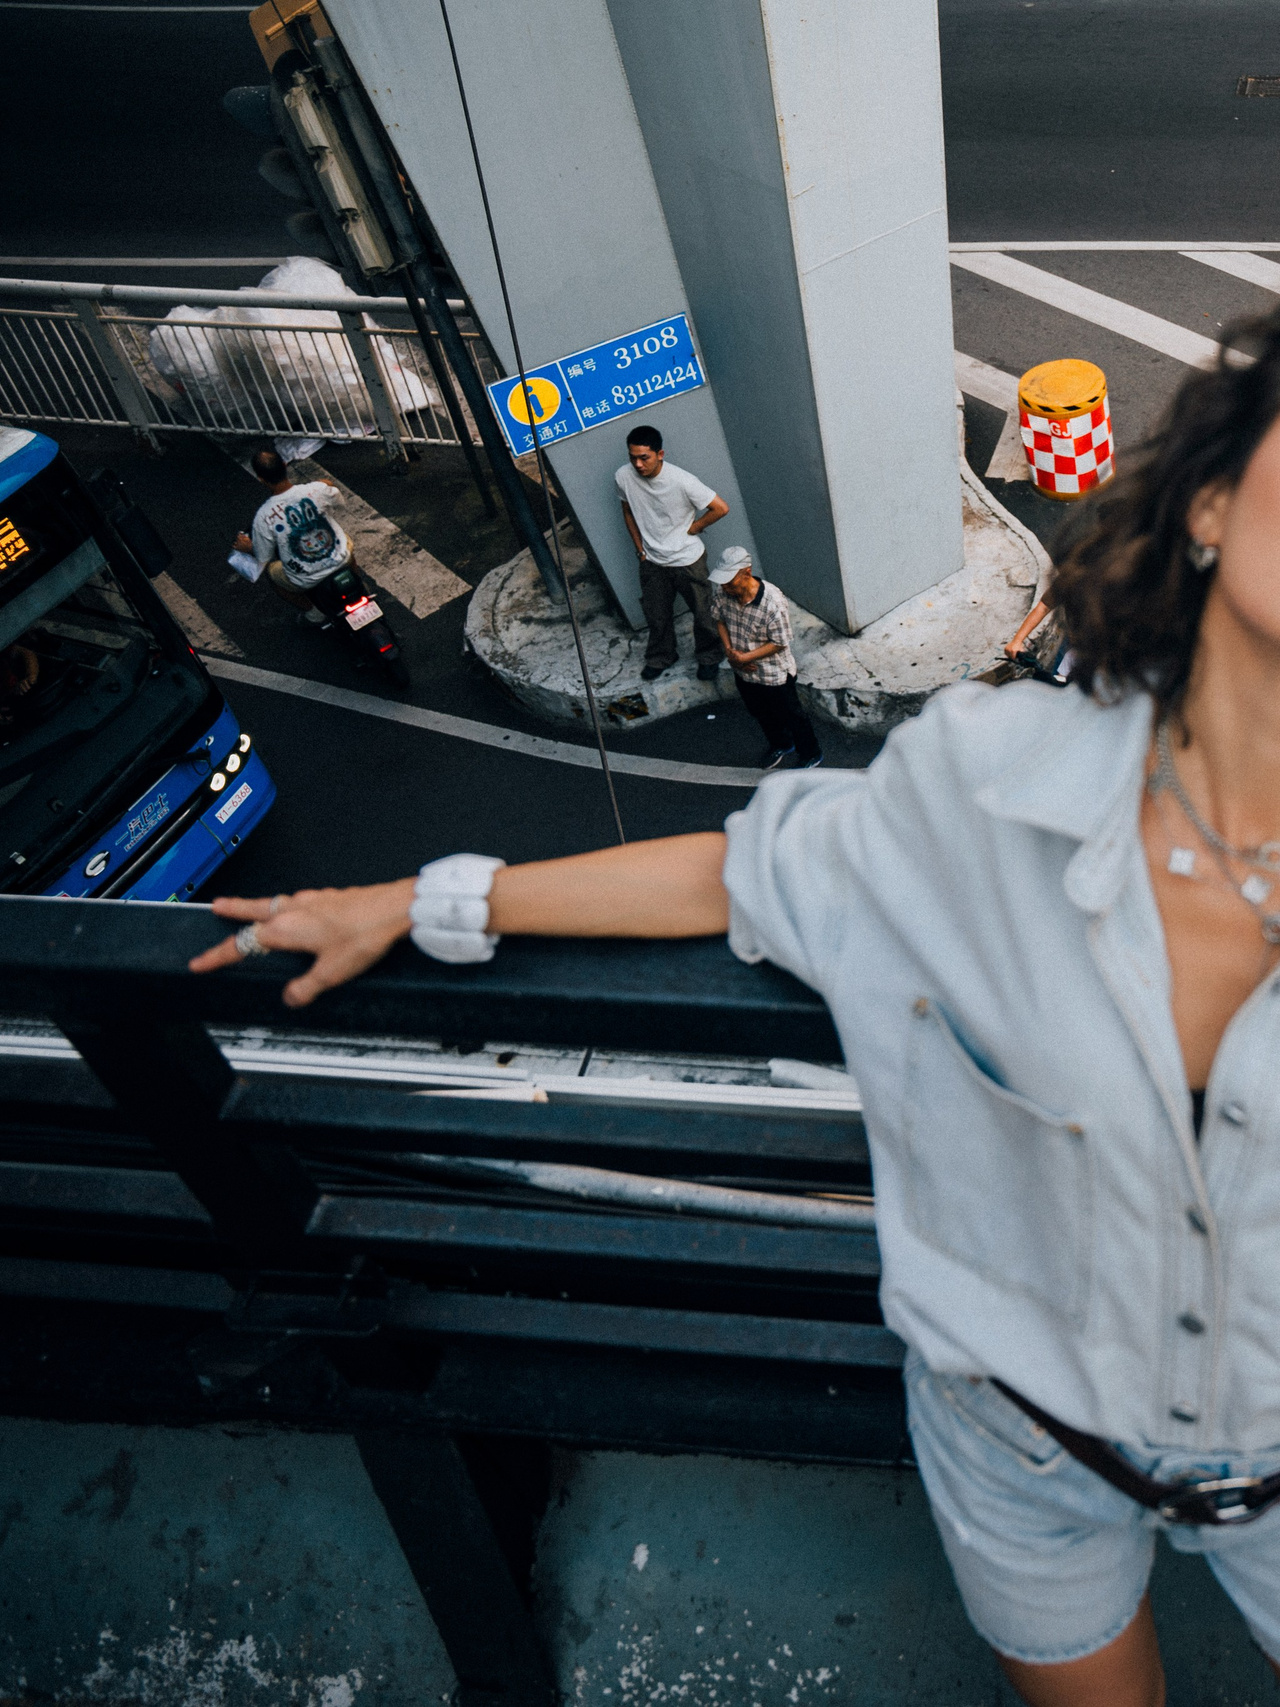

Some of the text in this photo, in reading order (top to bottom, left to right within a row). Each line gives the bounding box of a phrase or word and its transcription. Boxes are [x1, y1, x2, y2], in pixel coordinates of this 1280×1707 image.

[567, 326, 678, 379] 编号 3108
[581, 361, 697, 419] 电话 83112424
[522, 419, 568, 448] 交通灯
[1050, 422, 1071, 437] GJ
[115, 792, 169, 846] 一汽巴士
[217, 784, 251, 821] Y1-6368
